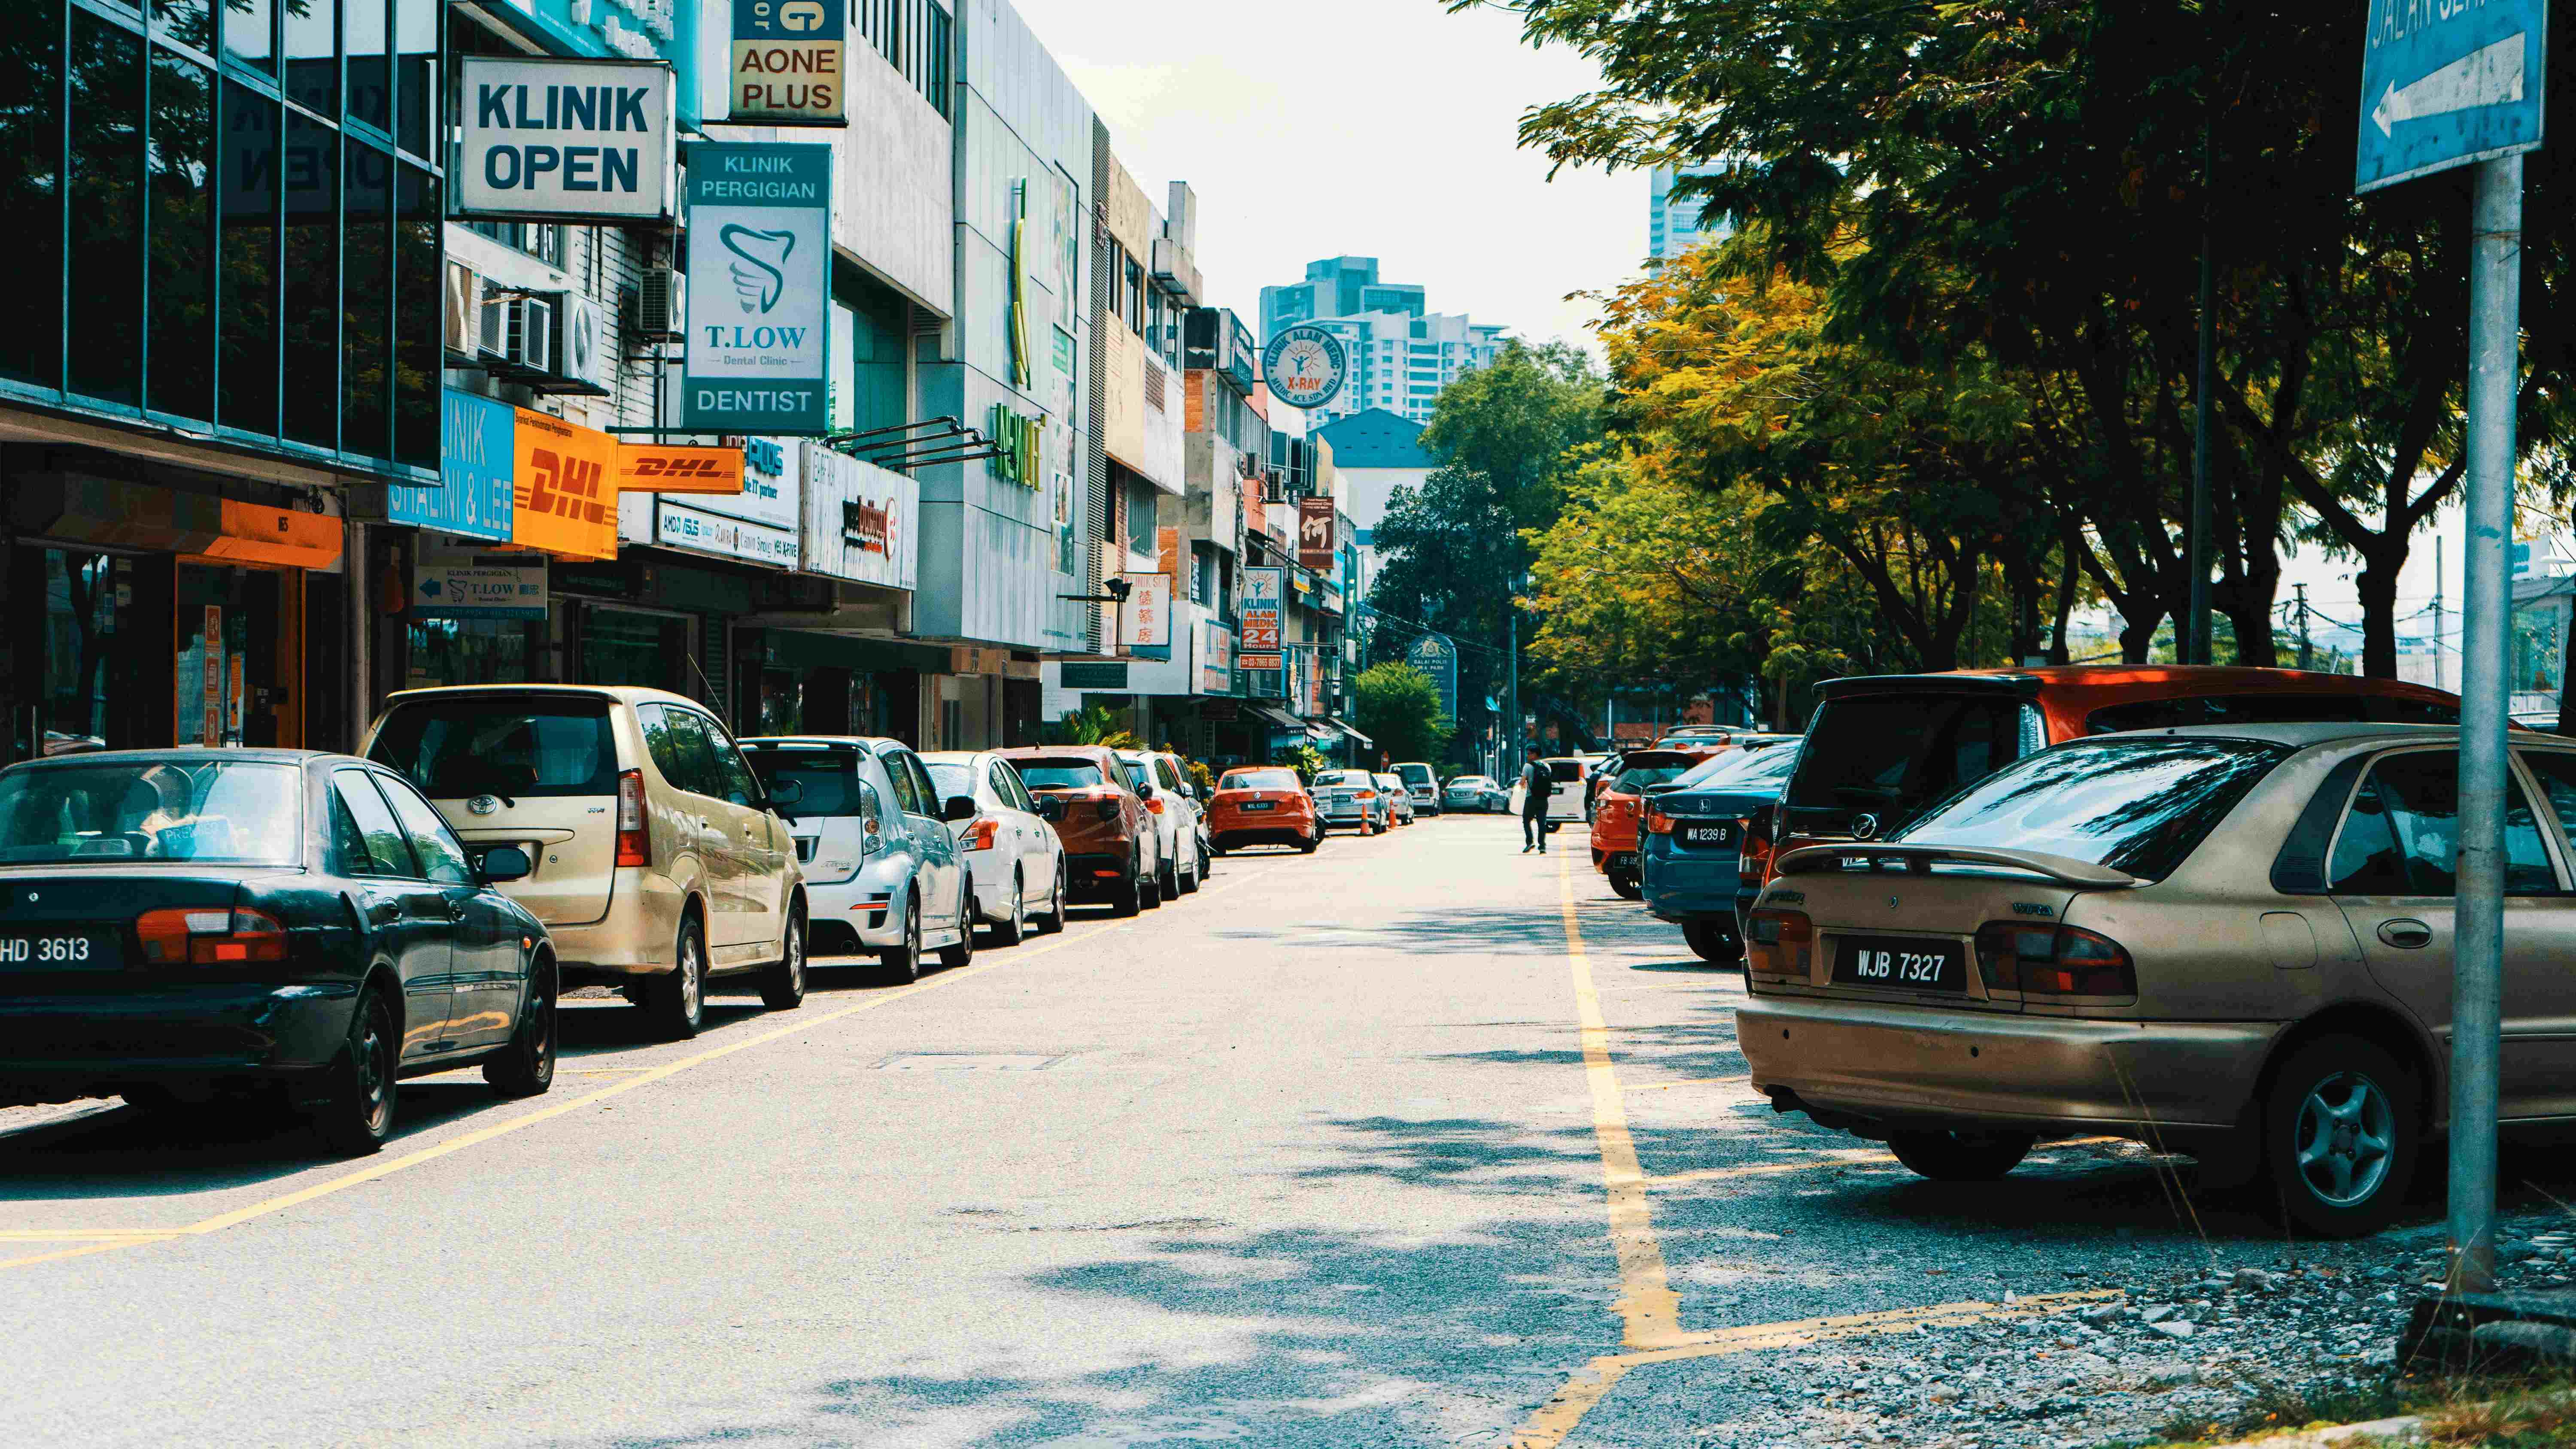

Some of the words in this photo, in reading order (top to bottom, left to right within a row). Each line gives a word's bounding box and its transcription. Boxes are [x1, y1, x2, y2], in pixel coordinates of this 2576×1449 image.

[740, 49, 836, 73] AONE
[743, 84, 832, 109] PLUS
[479, 84, 649, 132] KLINIK
[485, 144, 638, 192] OPEN
[725, 156, 794, 173] KLINIK
[701, 180, 815, 199] PERGIGIAN
[705, 325, 807, 349] T.LOW
[724, 355, 756, 365] Dental
[759, 355, 787, 366] Clinic
[1268, 336, 1291, 367] KLINIK
[1293, 330, 1323, 343] ALAM
[1323, 335, 1340, 370] MEDIC
[698, 390, 812, 412] DENTIST
[1293, 394, 1307, 402] ACE
[635, 458, 724, 477] DHL
[529, 447, 606, 524] DHL
[752, 479, 758, 494] IT
[759, 484, 778, 500] partner
[466, 471, 477, 526] &
[483, 477, 512, 532] LEE
[664, 515, 676, 533] AMD
[471, 583, 515, 594] T.LOW
[1244, 598, 1278, 609] KLINIK
[1243, 619, 1278, 628] MEDIC
[1243, 630, 1278, 644] 24
[1687, 828, 1697, 840] WA
[1699, 828, 1718, 840] 1239
[1720, 828, 1726, 841] B
[38, 937, 89, 961] 3613
[1858, 950, 1890, 977] WJB
[1900, 952, 1945, 982] 7327
